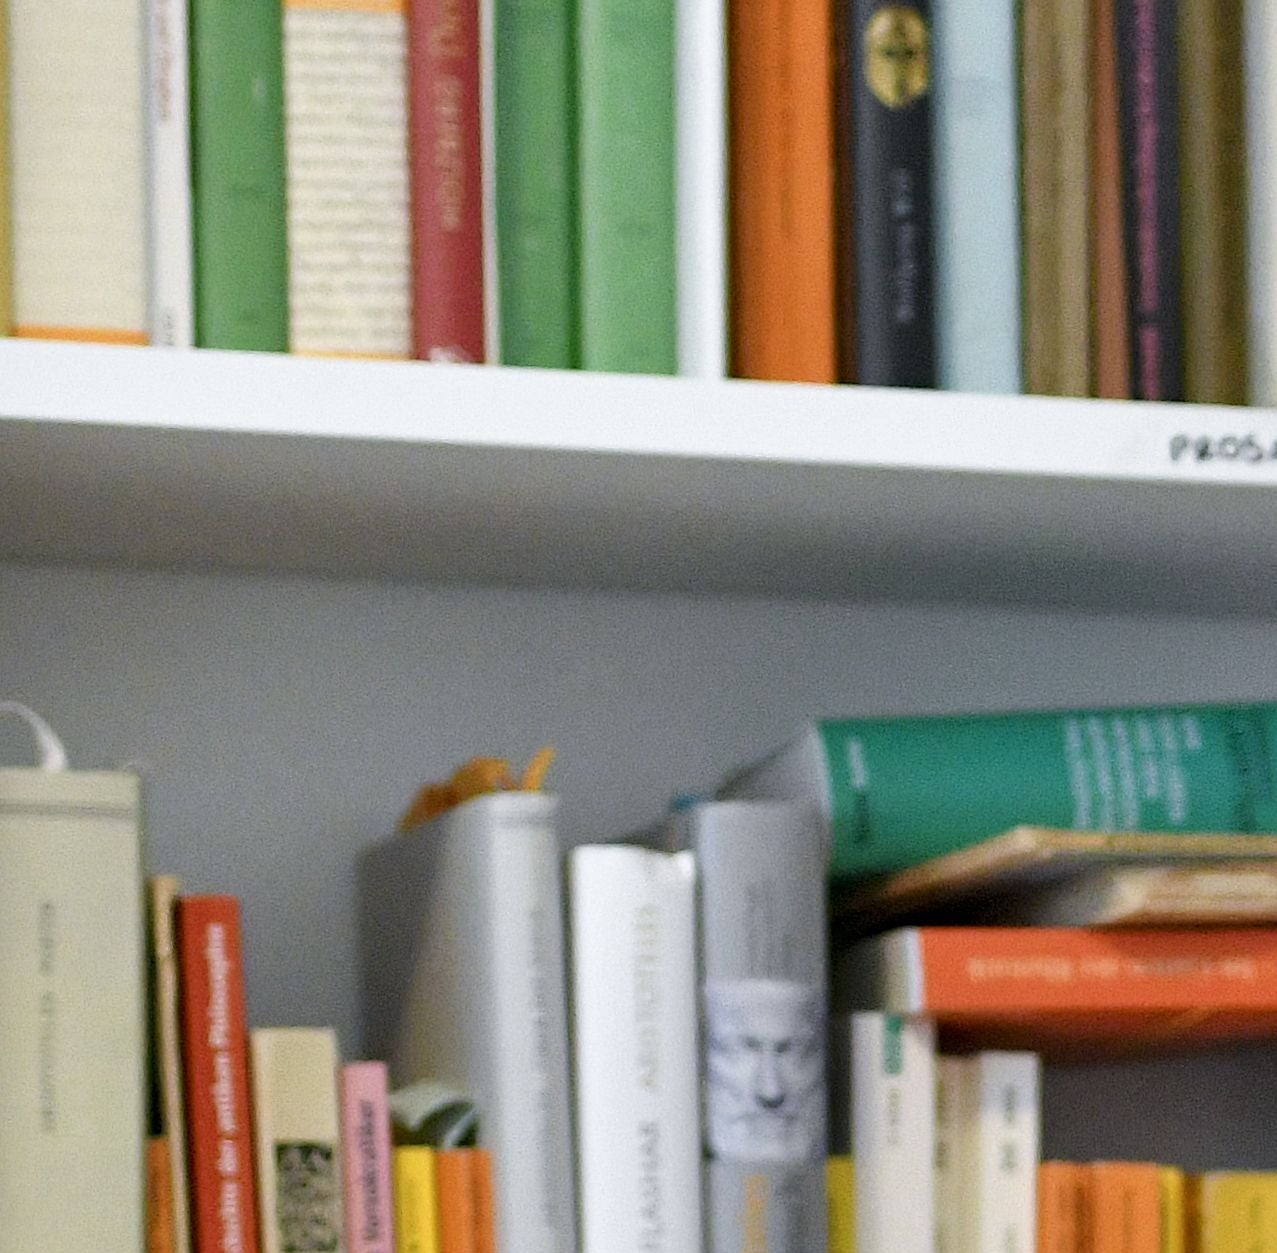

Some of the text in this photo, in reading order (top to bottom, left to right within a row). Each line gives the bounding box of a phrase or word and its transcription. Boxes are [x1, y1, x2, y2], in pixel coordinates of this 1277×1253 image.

[202, 922, 234, 1046] Philosophie
[633, 903, 662, 1093] ARISTOTELES
[213, 1140, 236, 1175] der
